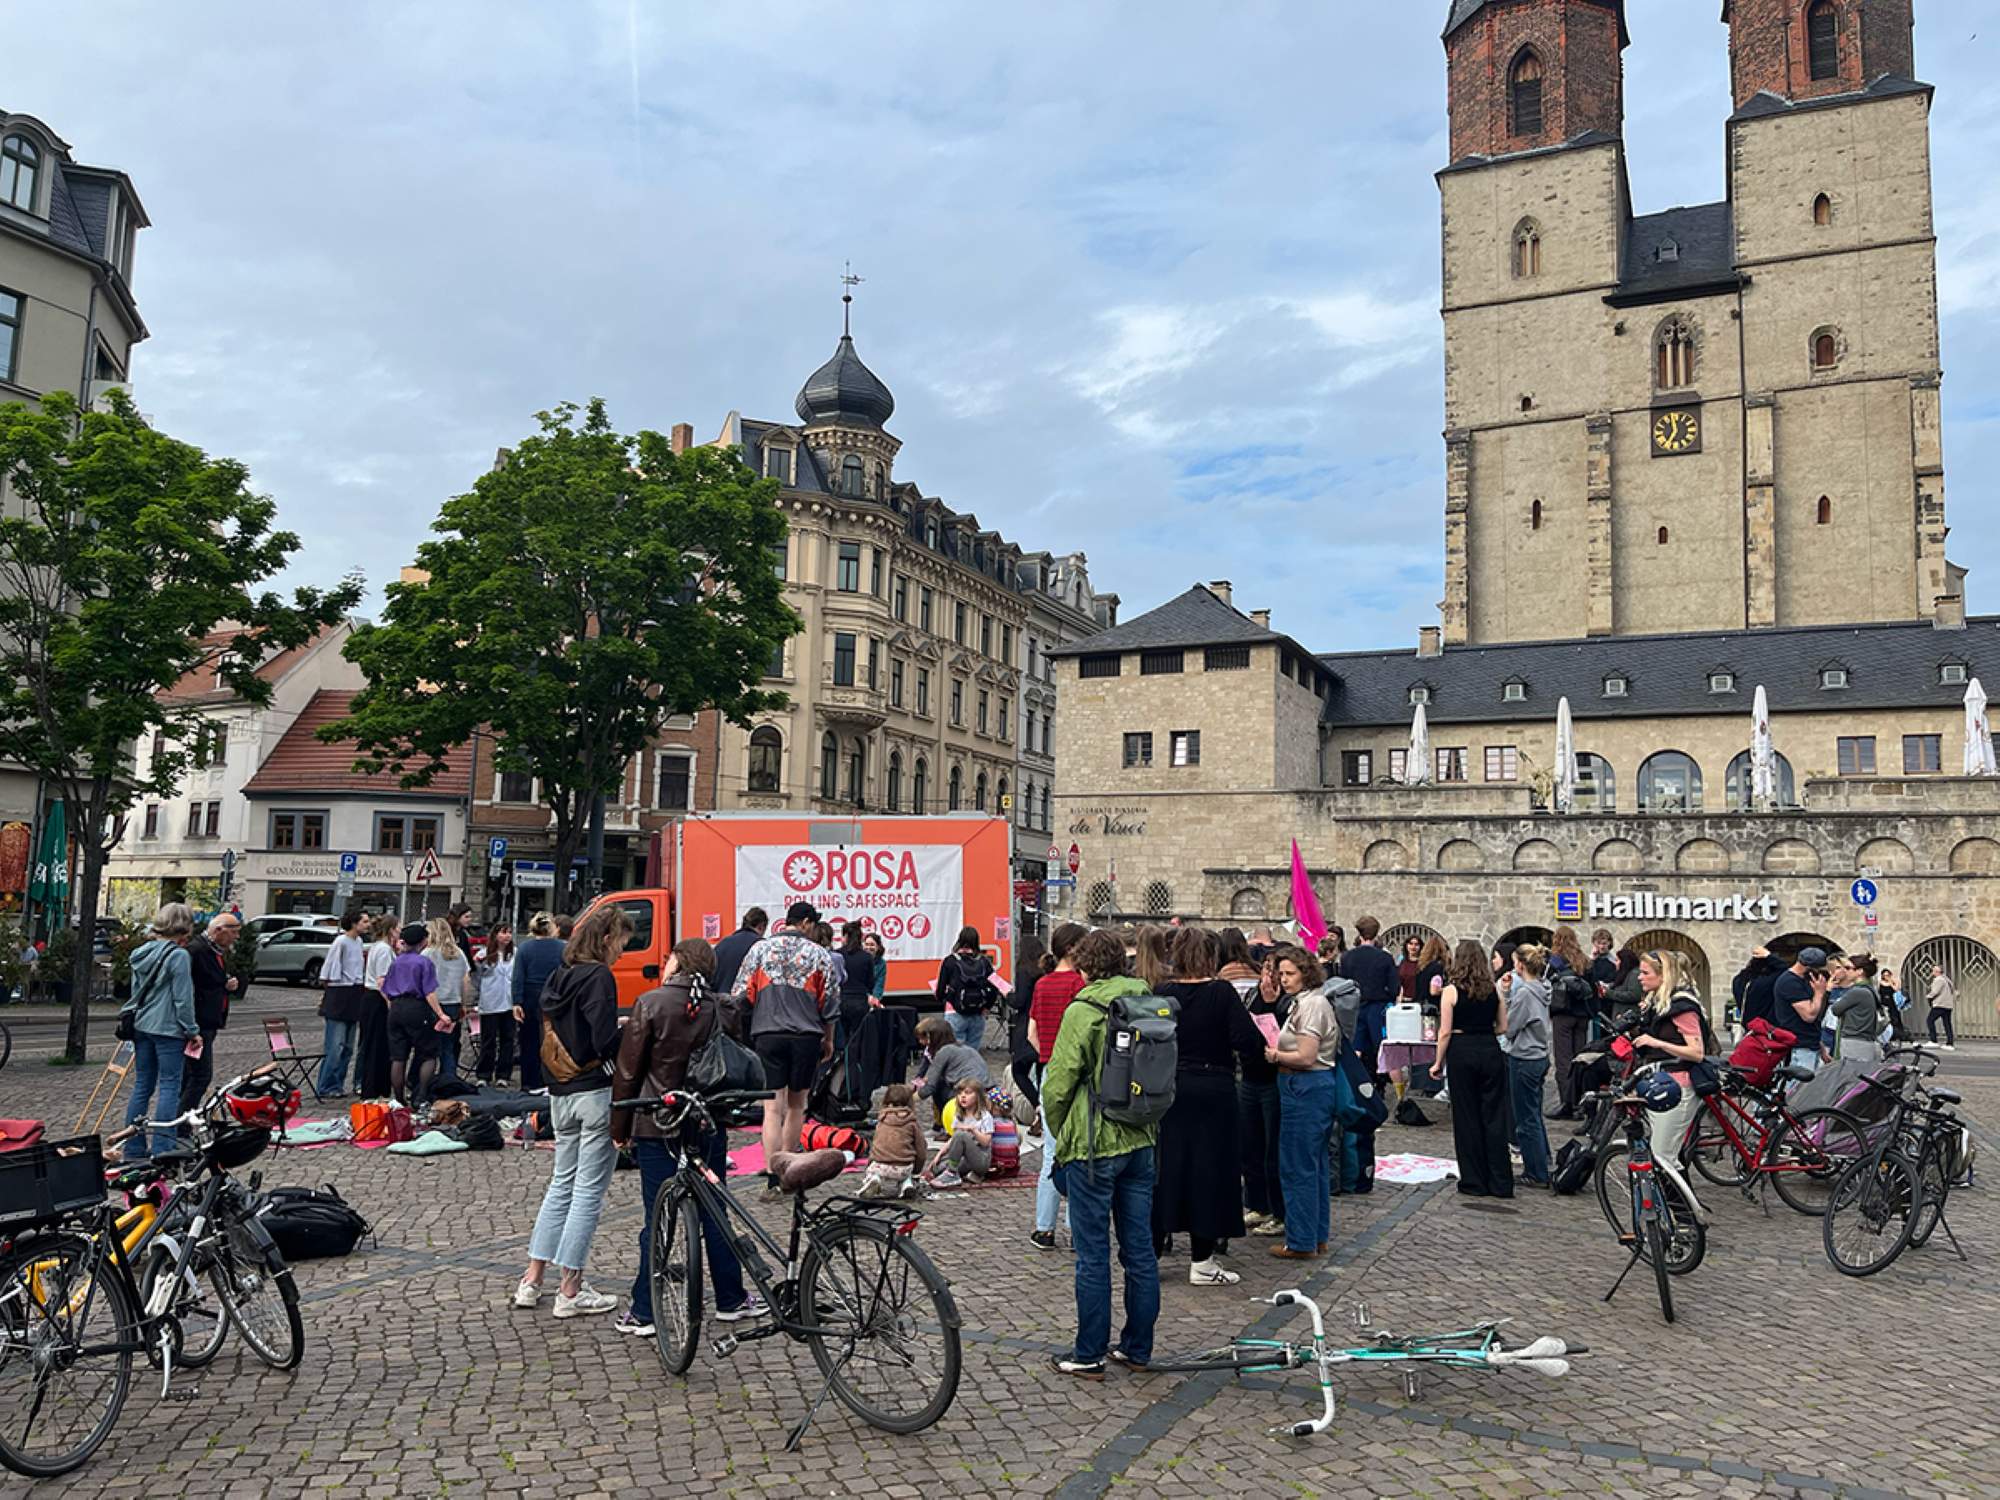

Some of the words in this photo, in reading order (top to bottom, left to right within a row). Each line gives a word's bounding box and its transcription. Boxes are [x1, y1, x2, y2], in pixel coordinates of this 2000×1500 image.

[1069, 818, 1090, 834] da
[1098, 814, 1146, 835] Vinci
[492, 841, 503, 855] P
[344, 856, 354, 869] P
[826, 851, 919, 891] ROSA
[846, 893, 919, 908] SAFESPACE
[1589, 892, 1778, 922] Hallmarkt
